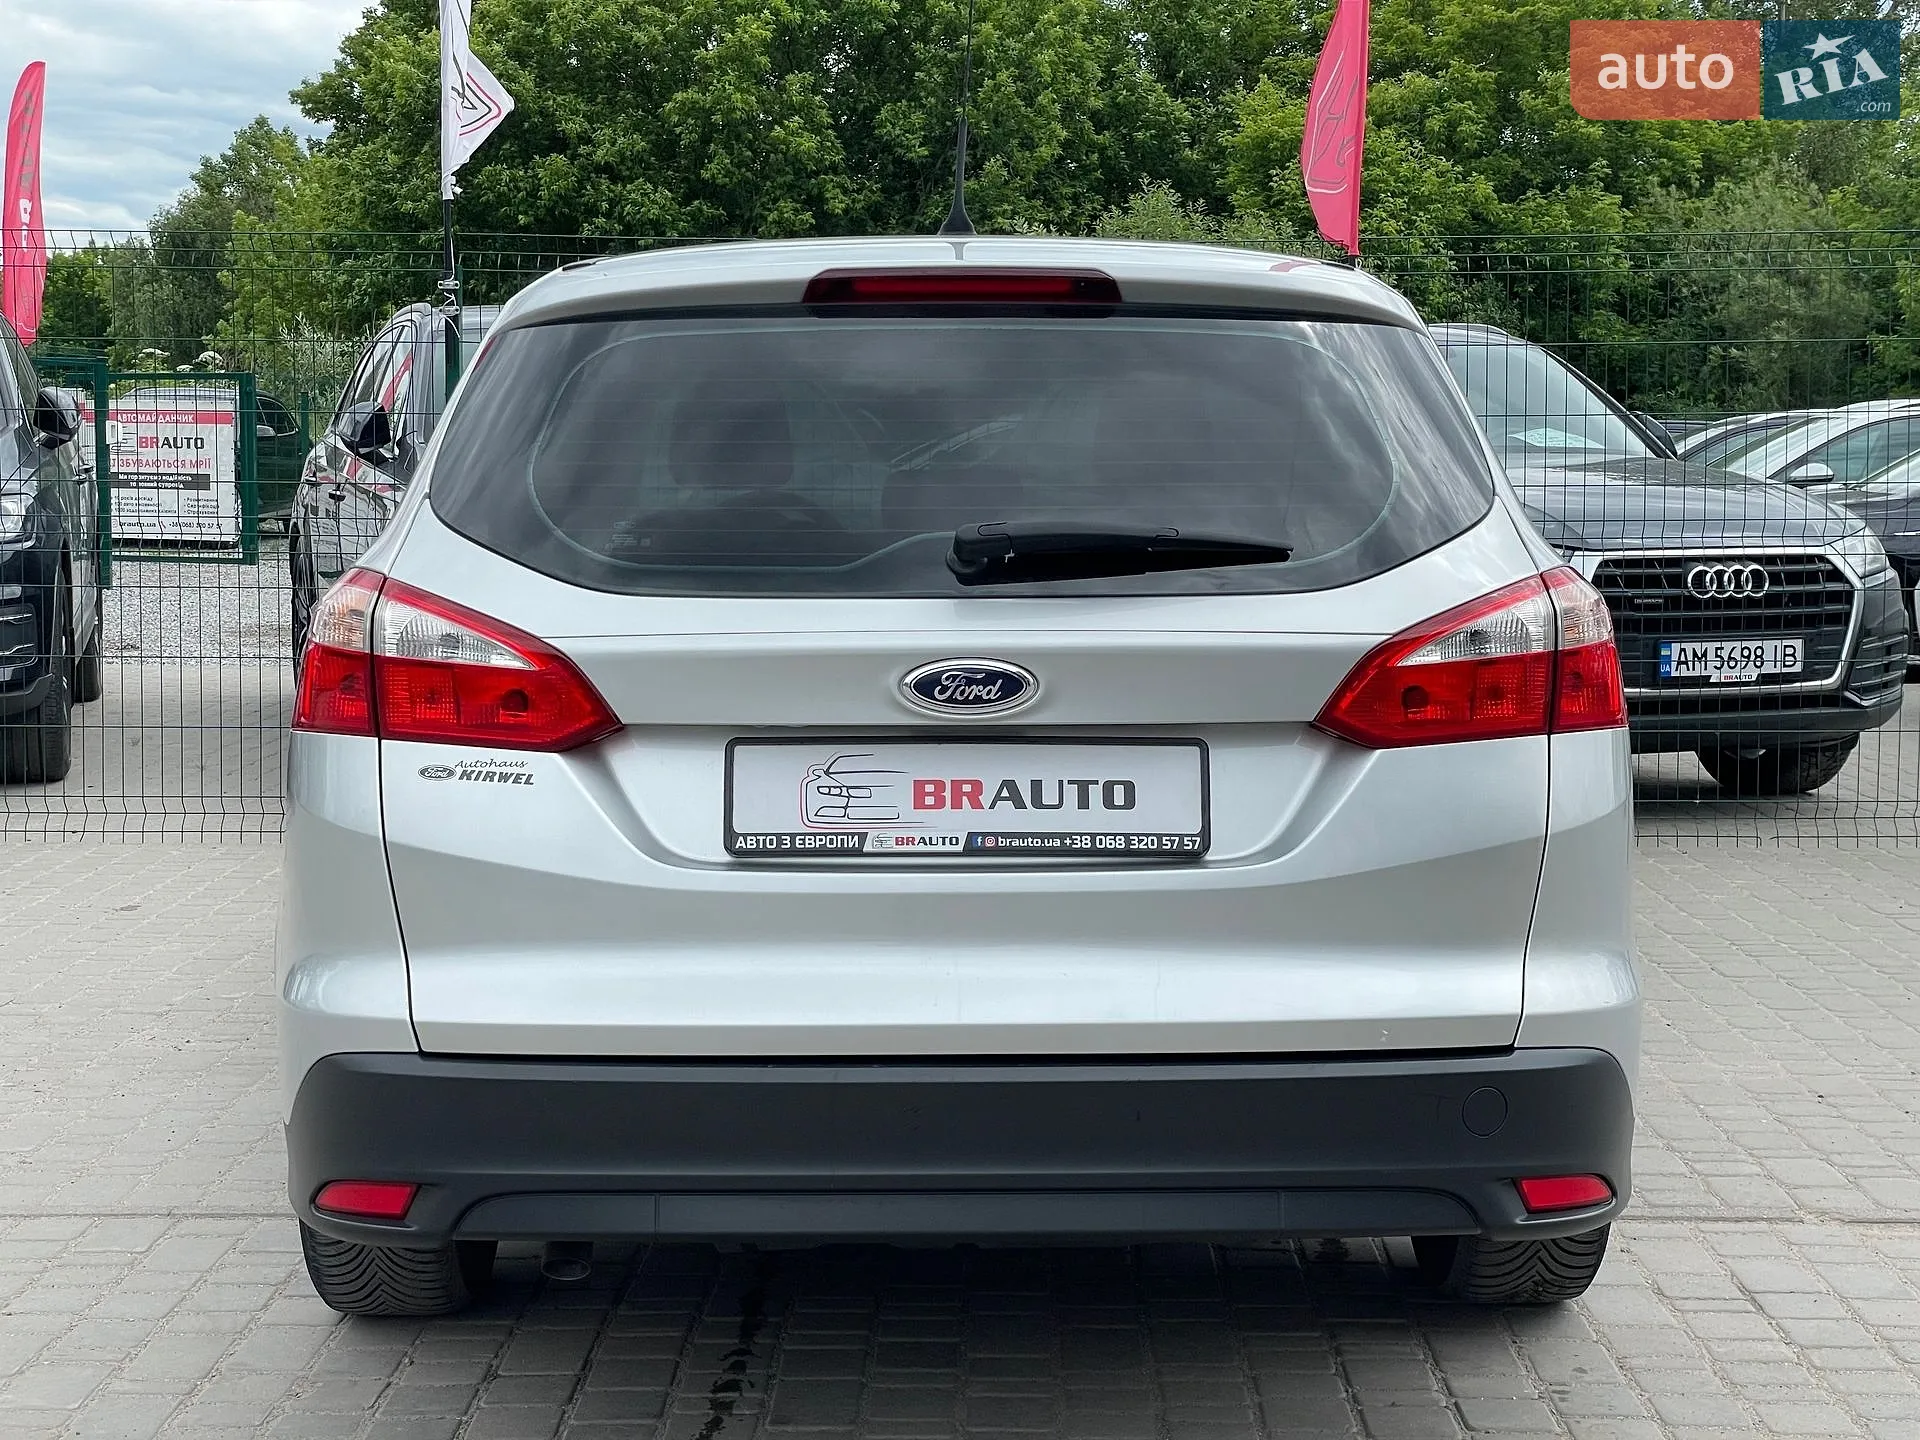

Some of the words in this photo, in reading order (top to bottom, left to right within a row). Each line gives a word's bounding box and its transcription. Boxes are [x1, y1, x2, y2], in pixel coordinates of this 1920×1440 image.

[117, 412, 194, 423] АВТОМАЙДАНЧИК
[138, 436, 205, 449] BRAUTO
[119, 458, 187, 469] ЗБУВАЮТЬСЯ
[189, 458, 211, 469] МРІЇ
[1675, 647, 1708, 672] AM
[1713, 645, 1765, 671] 5698
[1773, 644, 1798, 669] IB
[1660, 664, 1671, 672] UA
[934, 671, 1003, 701] Ford
[454, 758, 528, 769] Autohaus
[458, 769, 535, 786] KIRWEL
[912, 778, 1136, 811] BRAUTO
[735, 835, 777, 849] АВТО
[795, 835, 859, 849] ЄВРОПИ
[894, 836, 960, 847] BRAUTO
[998, 836, 1061, 848] brauto.ua
[1063, 836, 1092, 849] +38
[1095, 835, 1126, 849] 068
[1129, 836, 1158, 849] 320
[1162, 837, 1180, 850] 57
[1183, 837, 1201, 850] 57
